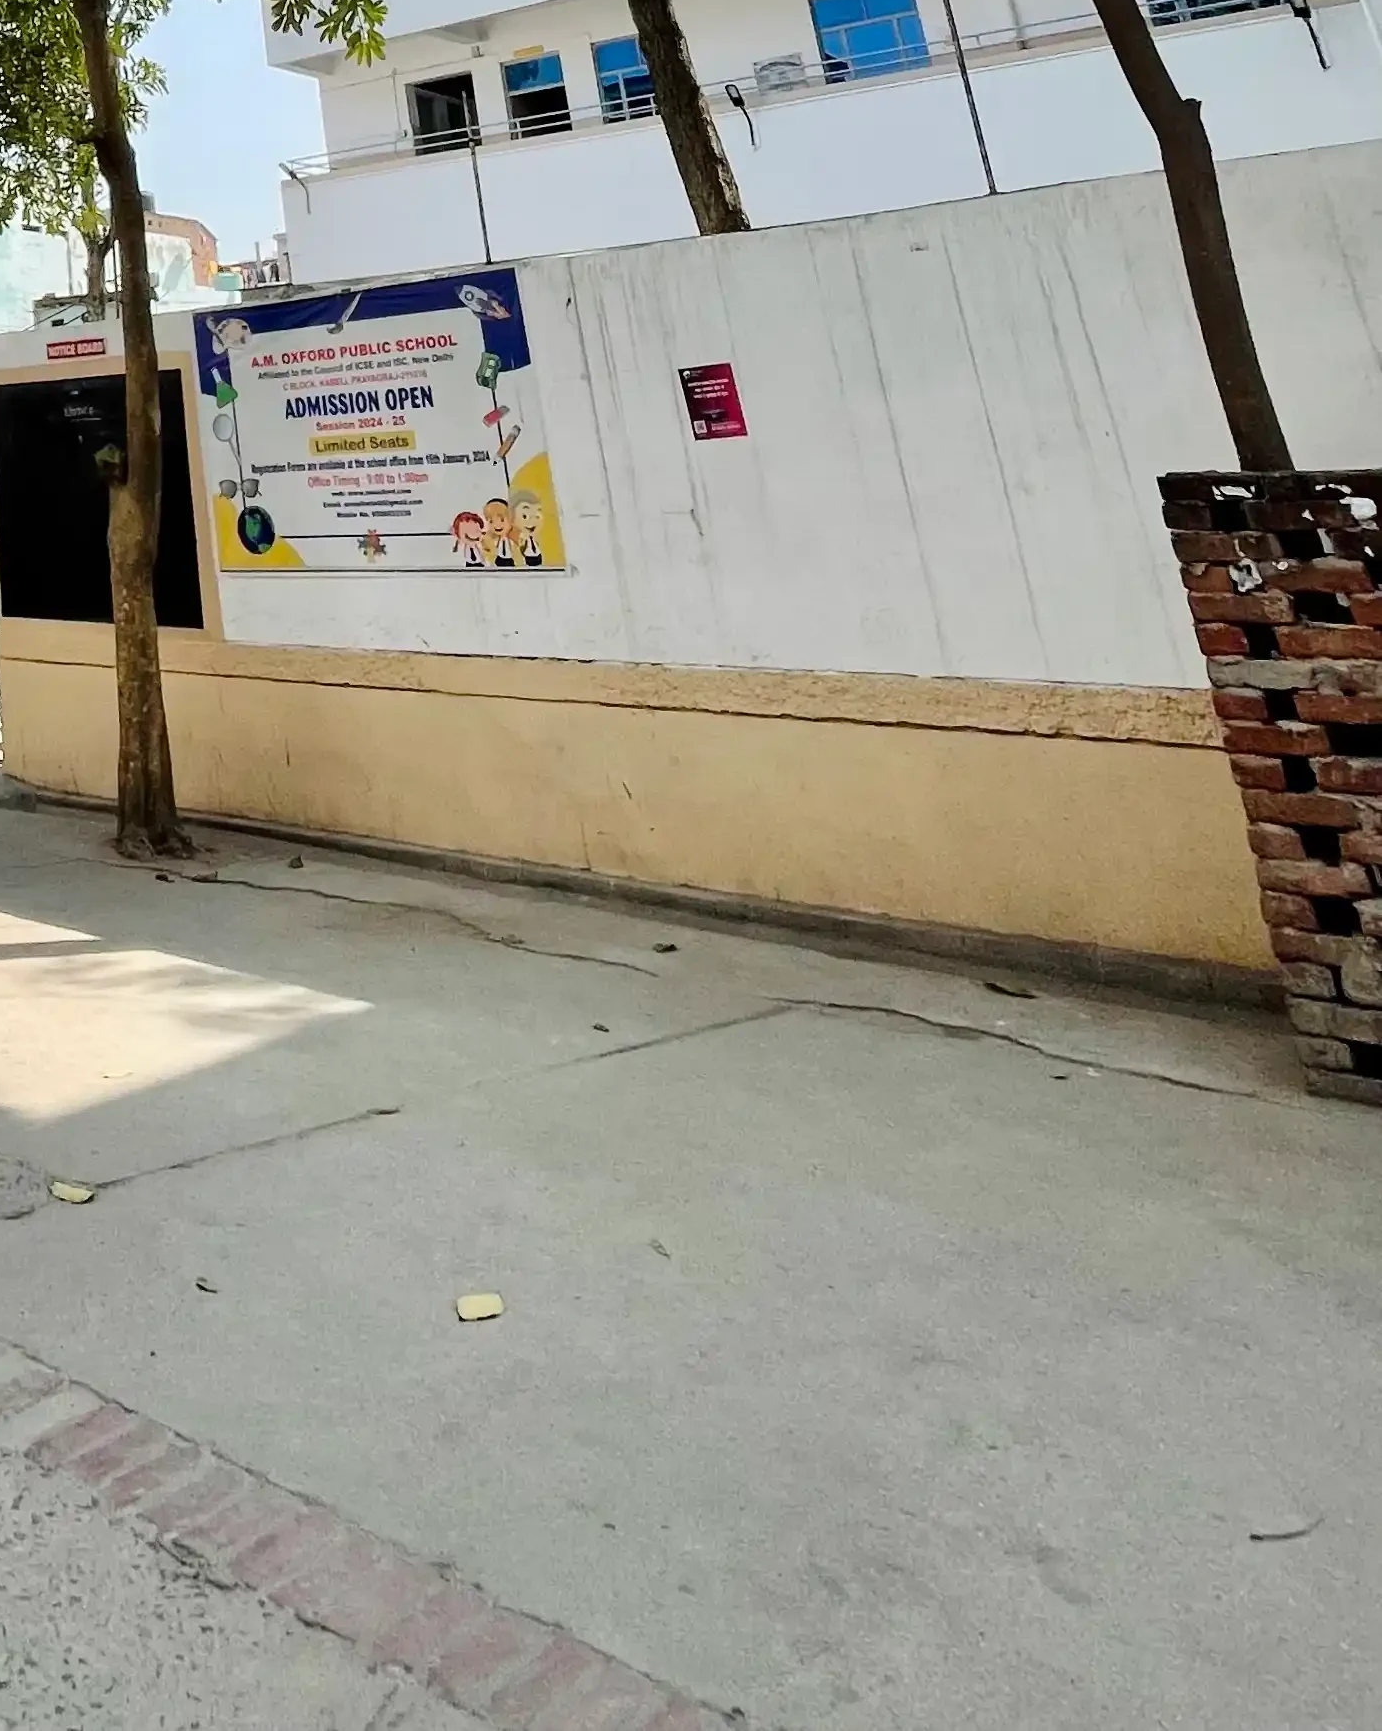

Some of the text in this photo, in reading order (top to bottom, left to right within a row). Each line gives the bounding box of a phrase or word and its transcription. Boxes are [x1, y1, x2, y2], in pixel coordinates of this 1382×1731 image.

[251, 334, 458, 368] A.M. OXFORD PUBLIC SCHOOL
[355, 360, 374, 371] ICSE
[377, 358, 391, 369] and
[285, 385, 434, 419] ADMISSION OPEN
[315, 420, 356, 431] Session
[358, 417, 383, 428] 2024
[392, 415, 407, 427] 25
[315, 436, 410, 453] Limited Seats
